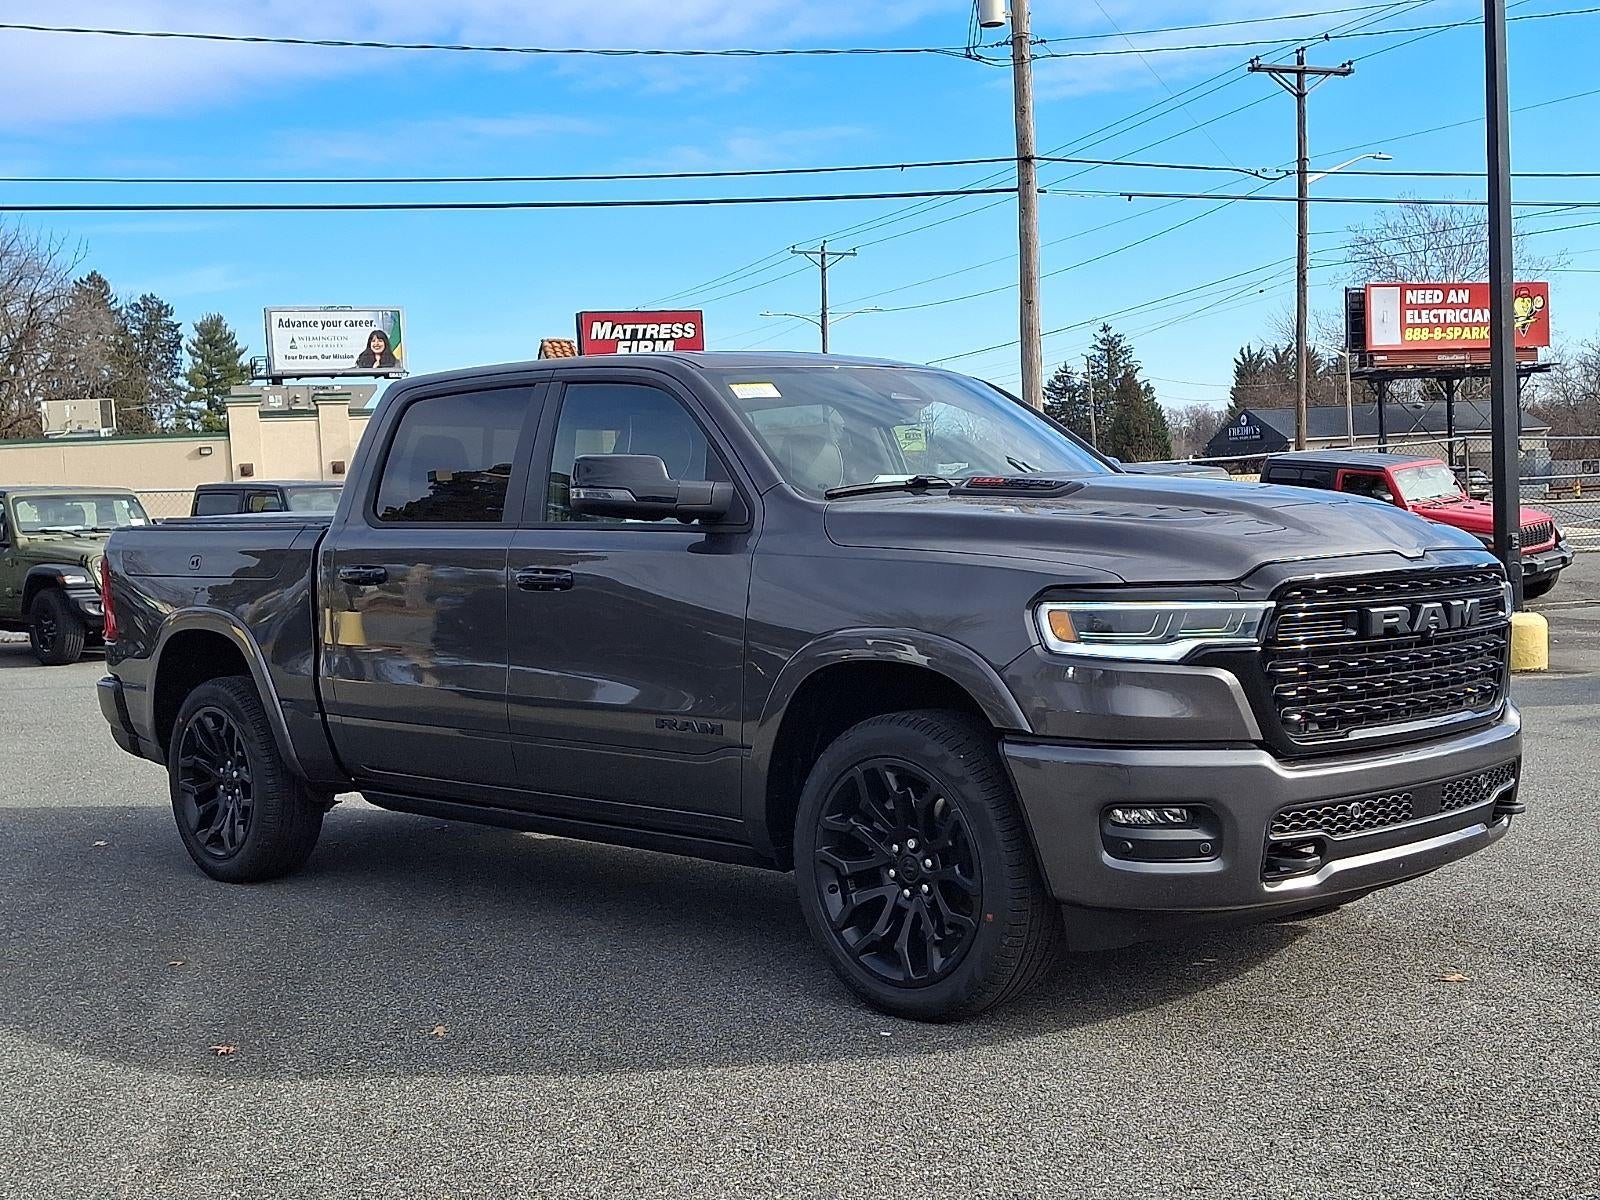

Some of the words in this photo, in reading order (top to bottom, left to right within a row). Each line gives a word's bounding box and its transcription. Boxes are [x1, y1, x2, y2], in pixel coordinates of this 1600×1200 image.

[1405, 289, 1443, 304] NEED
[1447, 289, 1469, 304] AN
[278, 318, 318, 328] Advance
[321, 320, 342, 330] your
[344, 319, 377, 328] career.
[1405, 308, 1490, 324] ELECTRICIAN
[590, 321, 696, 340] MATTRESS
[617, 340, 675, 354] FIRM
[1367, 599, 1480, 636] RAM
[655, 718, 724, 736] RAM
